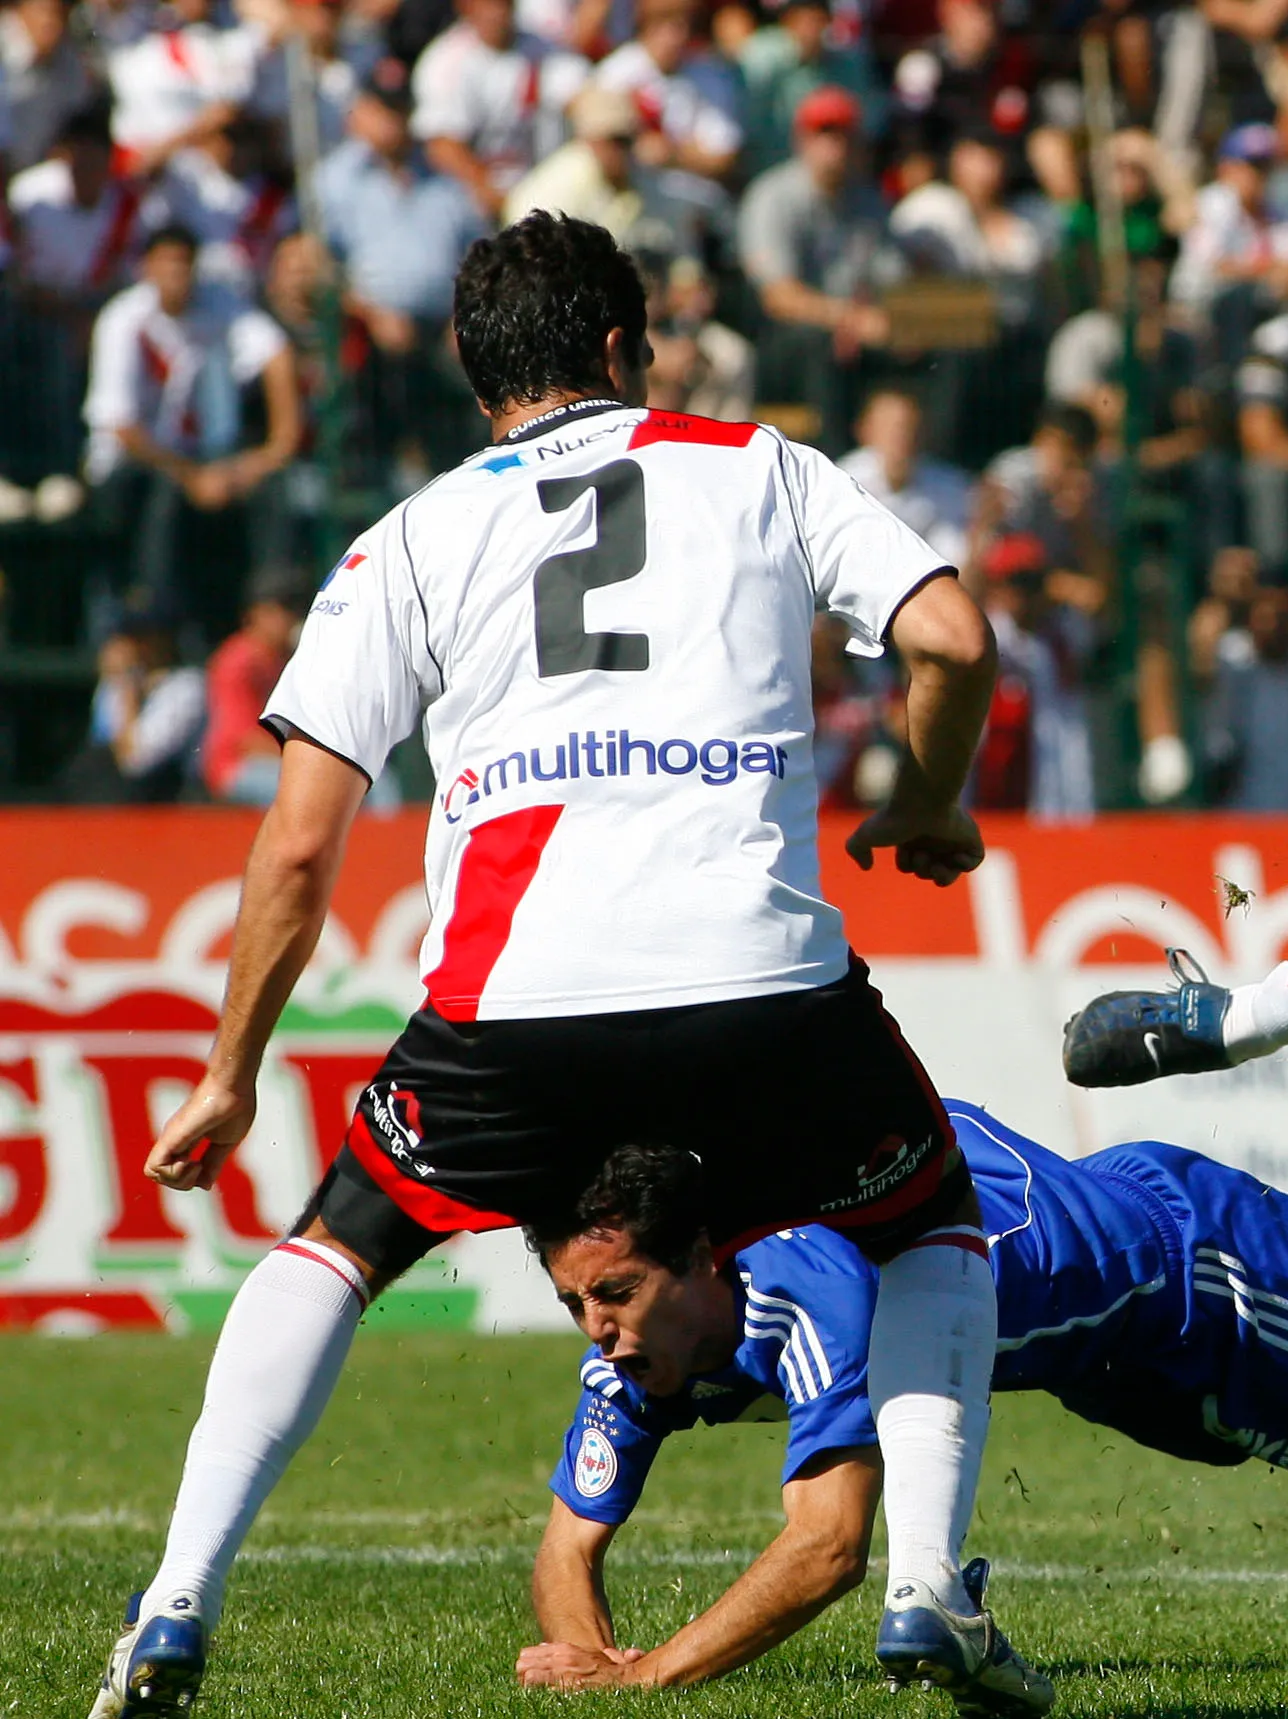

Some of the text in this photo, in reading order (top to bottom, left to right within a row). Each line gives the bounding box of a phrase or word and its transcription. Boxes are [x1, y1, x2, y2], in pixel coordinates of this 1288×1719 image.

[508, 407, 566, 440] CURICO
[533, 458, 650, 678] 2
[483, 729, 789, 786] multihogar
